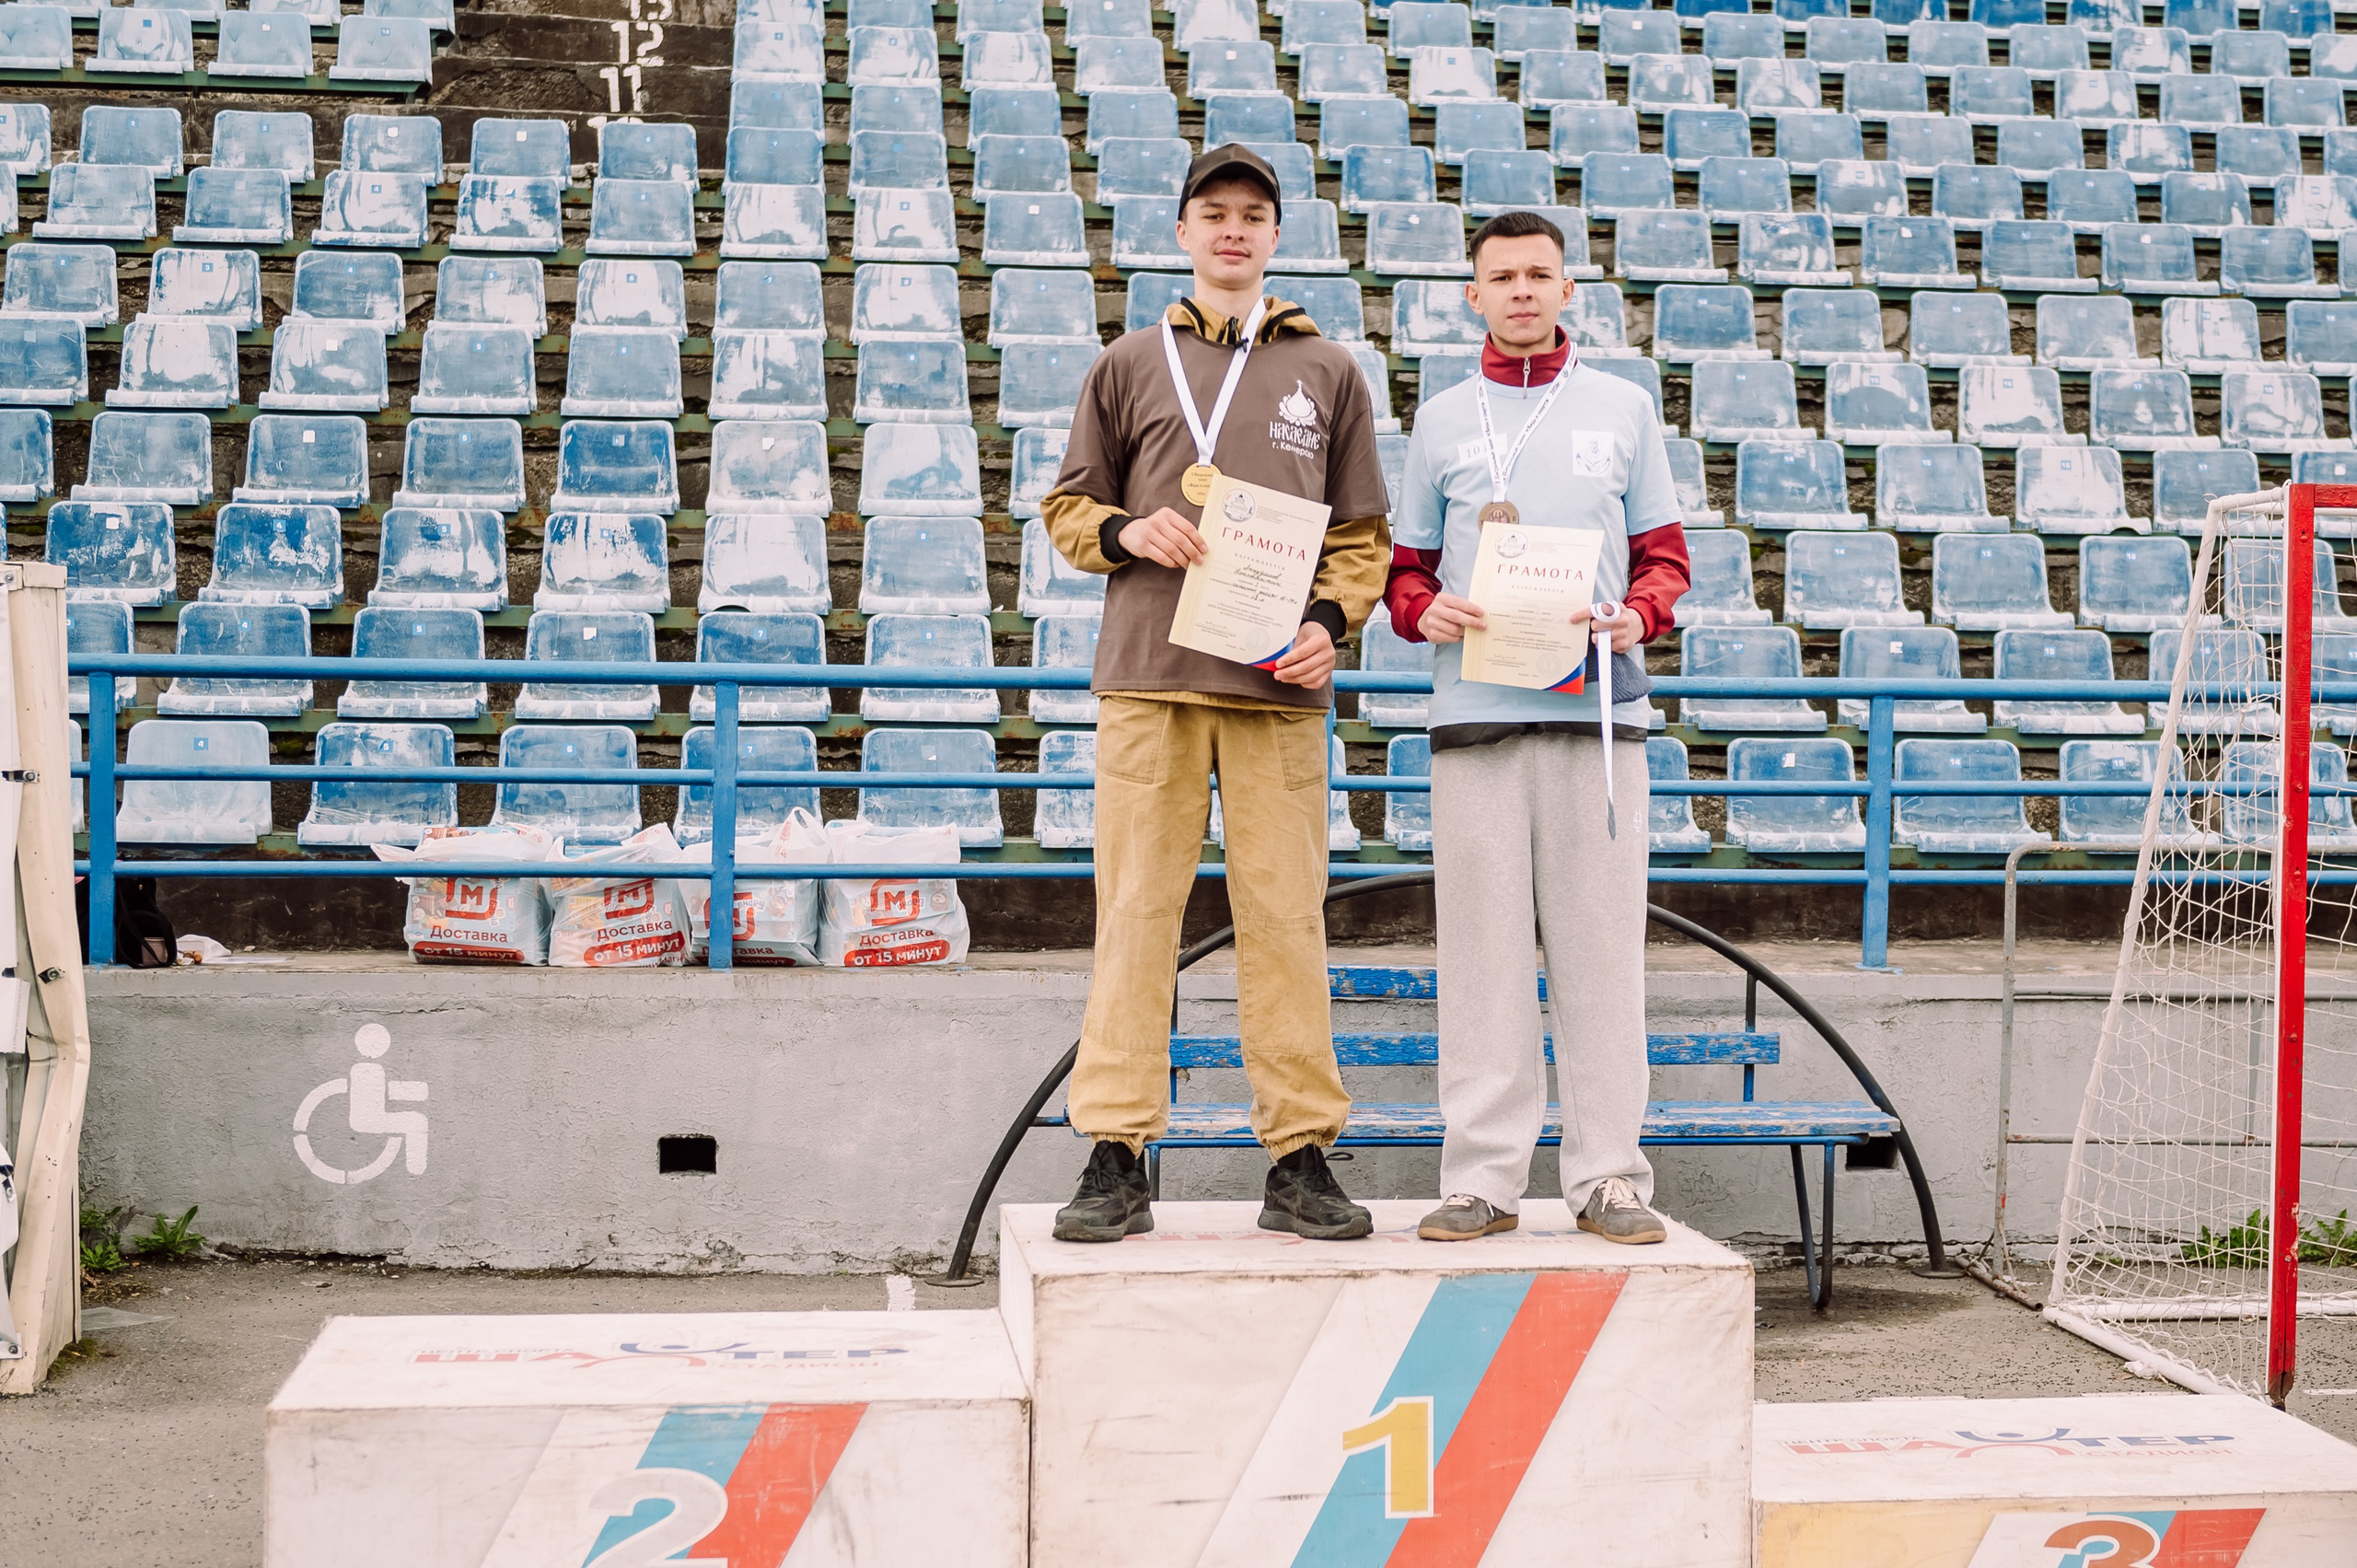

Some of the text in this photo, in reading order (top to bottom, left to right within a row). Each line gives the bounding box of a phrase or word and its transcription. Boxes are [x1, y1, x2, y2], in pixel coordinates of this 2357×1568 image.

[610, 20, 665, 67] 12
[599, 64, 643, 112] 11
[1222, 527, 1306, 561] ГРАМОТА
[1497, 563, 1584, 581] ГРАМОТА
[430, 924, 508, 943] Доставка
[597, 920, 673, 942] Доставка
[859, 929, 935, 947] Доставка
[446, 947, 463, 956] 15
[467, 950, 516, 962] минут
[593, 938, 680, 962] от 15 минут
[853, 946, 943, 966] от 15 минут
[1786, 1427, 2237, 1458] ШАХТЕР
[2084, 1448, 2234, 1458] СТАДИОН
[1341, 1395, 1434, 1520] 1
[586, 1468, 730, 1568] 2
